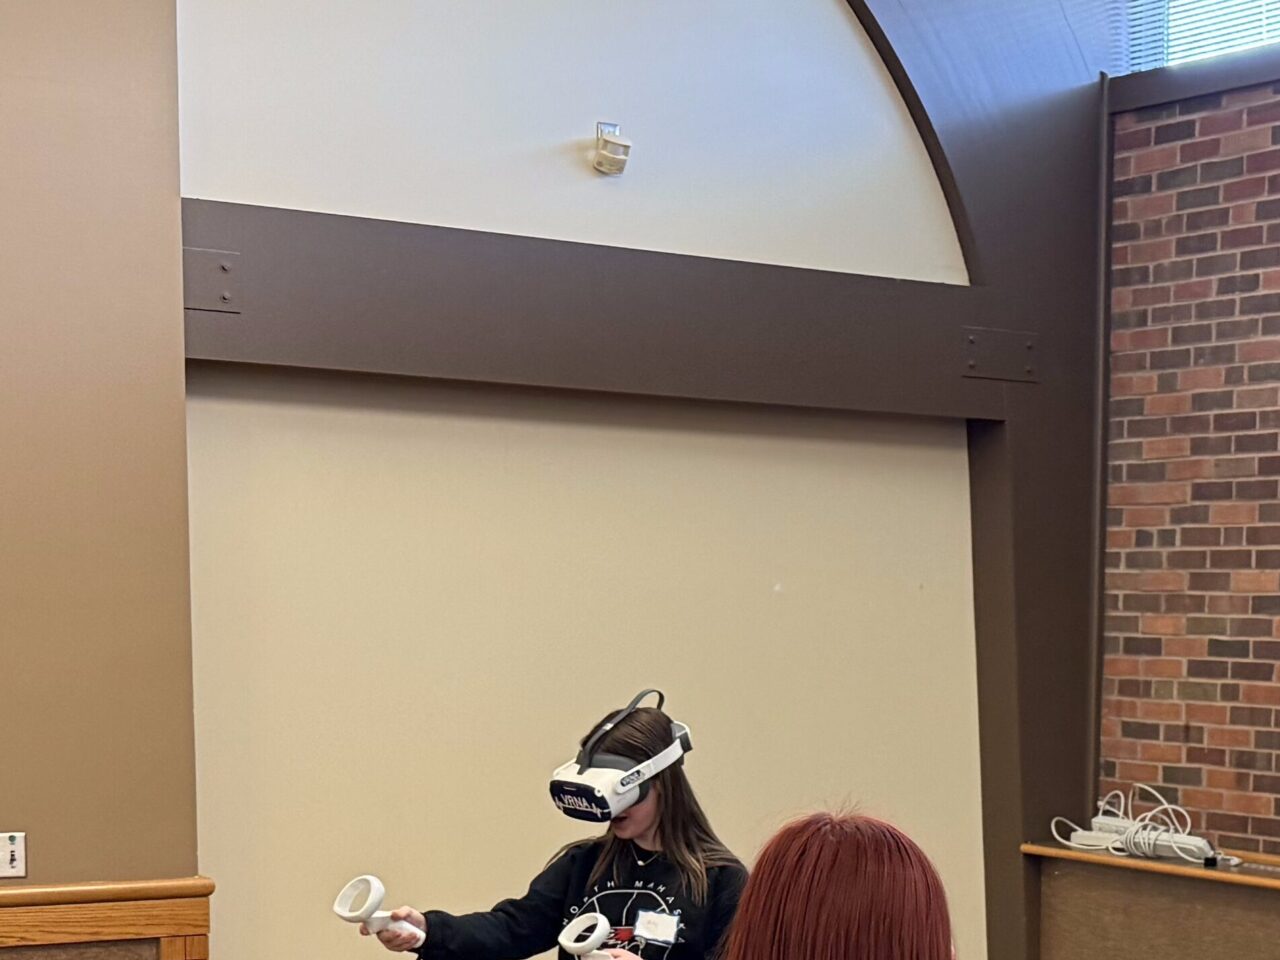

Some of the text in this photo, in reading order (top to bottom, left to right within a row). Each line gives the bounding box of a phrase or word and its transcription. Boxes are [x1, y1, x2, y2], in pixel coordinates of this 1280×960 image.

[560, 793, 591, 811] VRNA
[562, 880, 687, 943] NORTH MAHASKA
